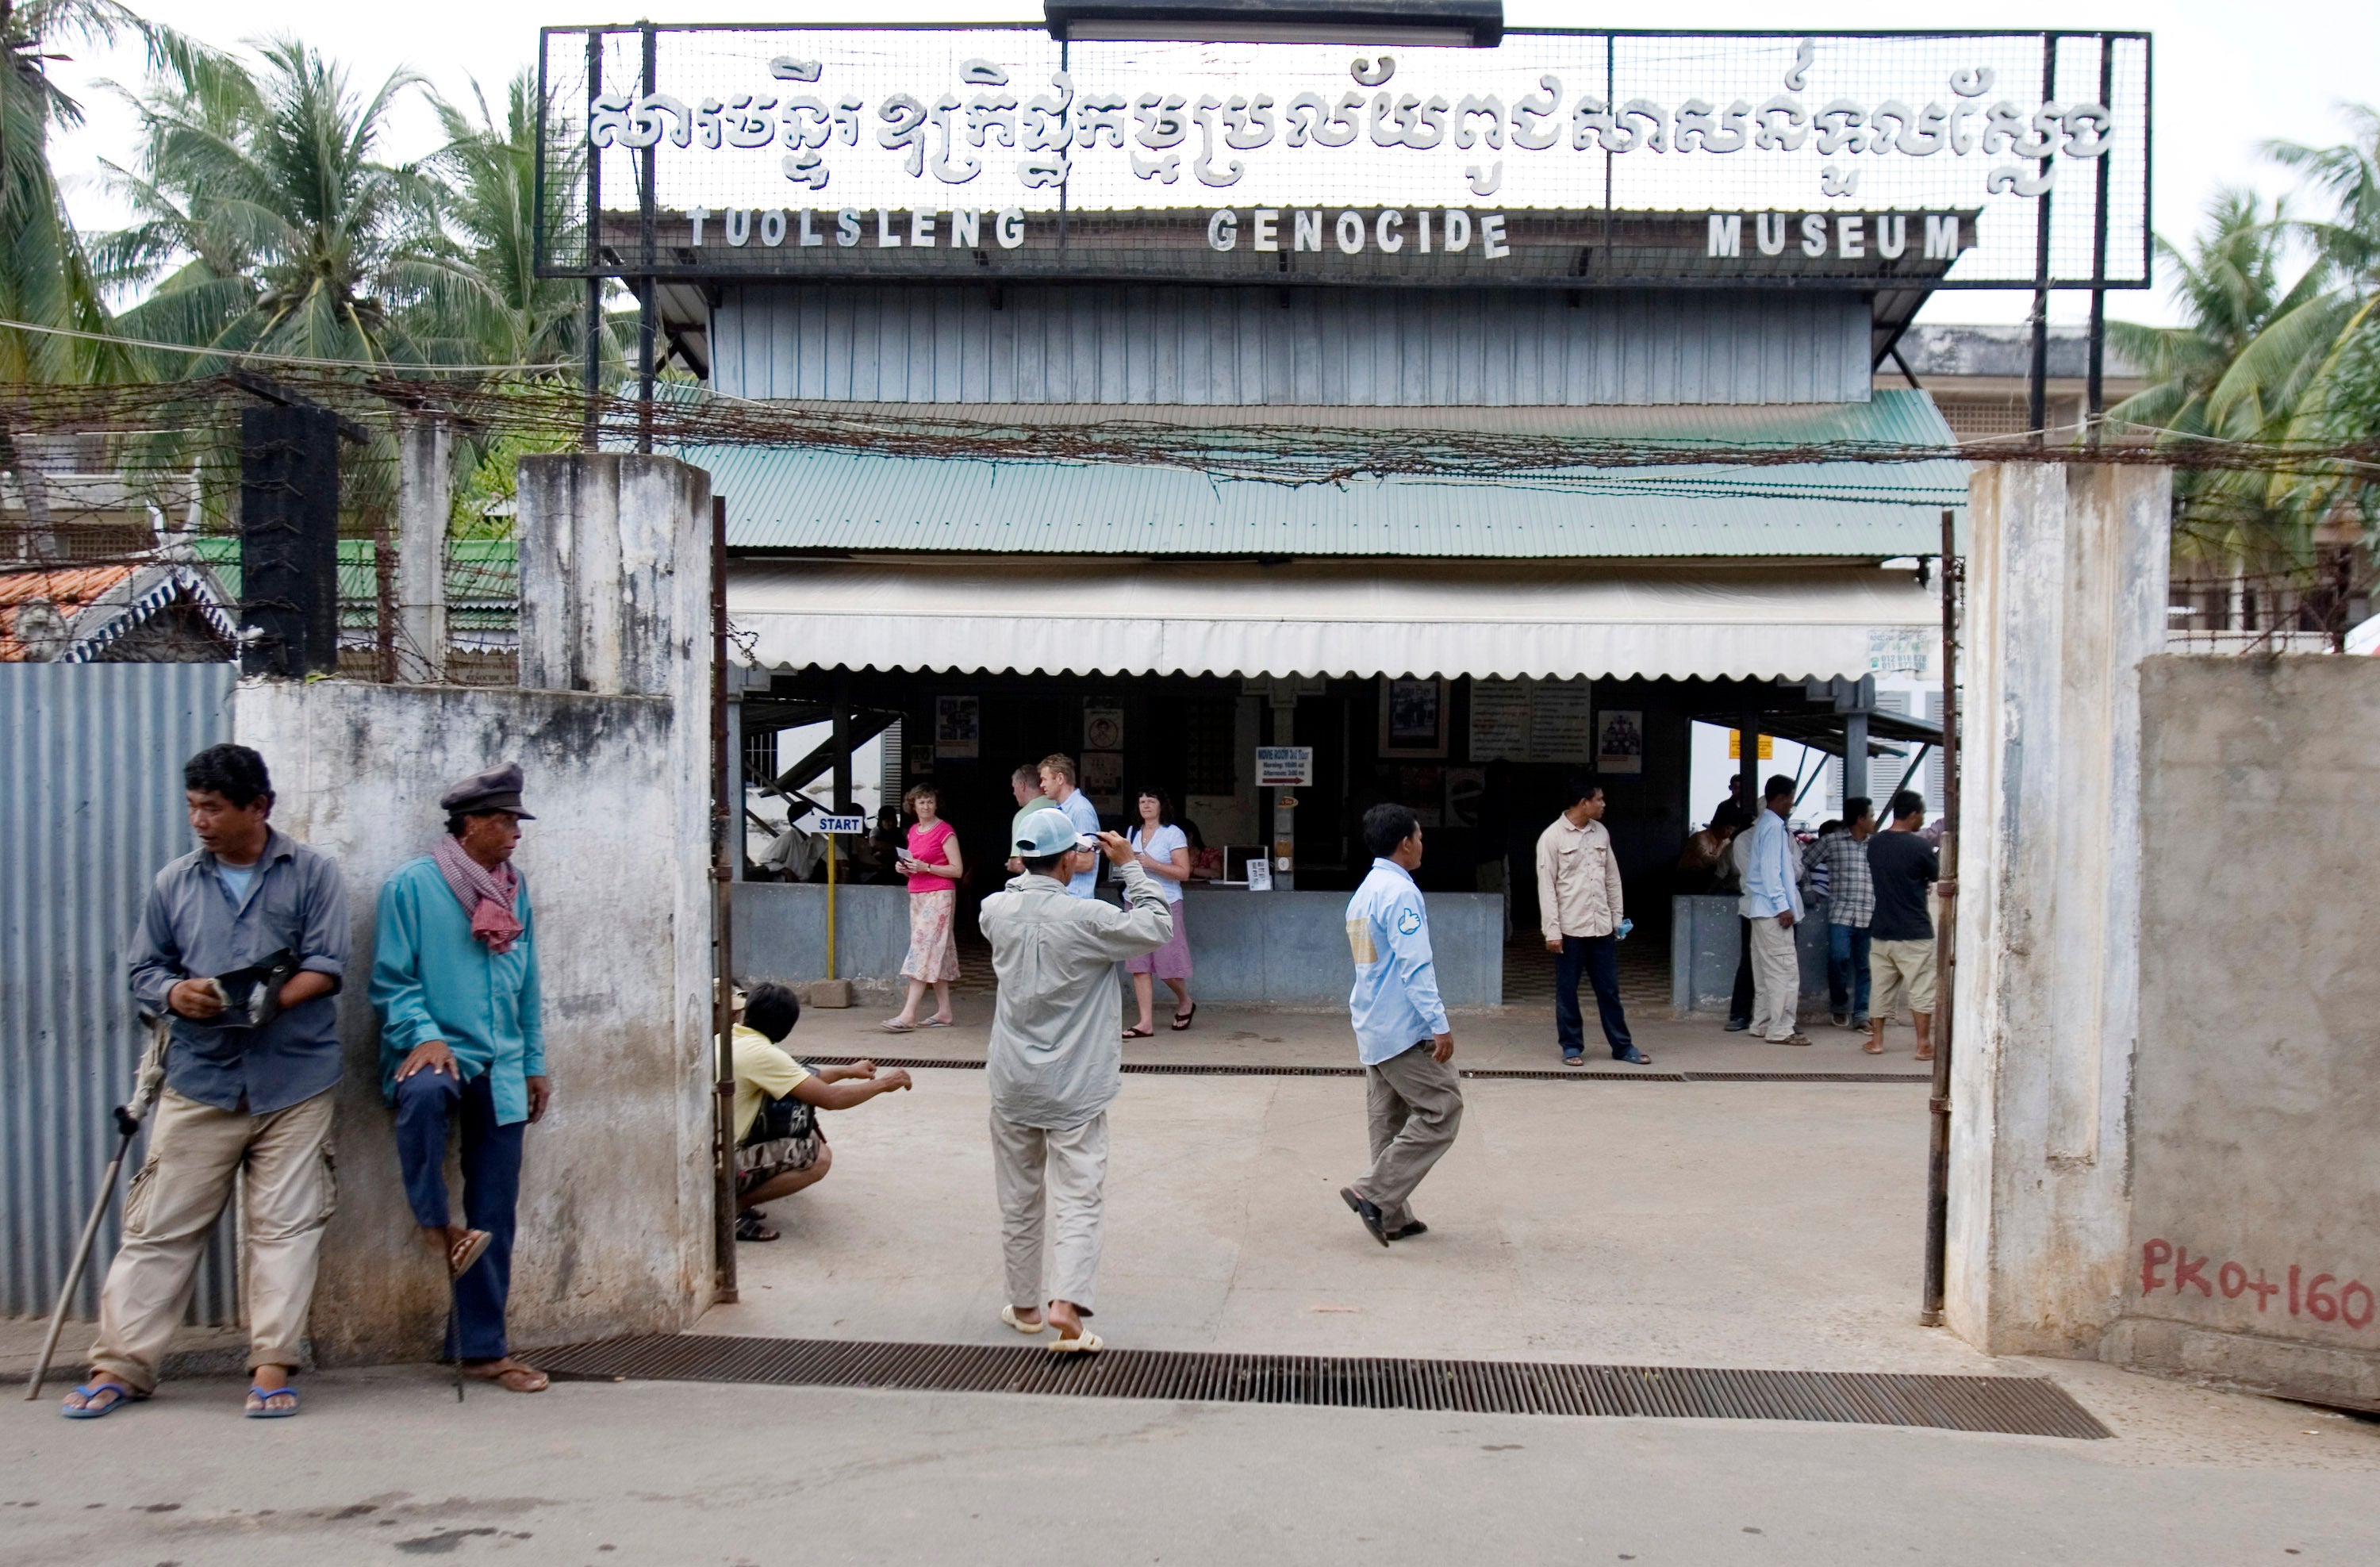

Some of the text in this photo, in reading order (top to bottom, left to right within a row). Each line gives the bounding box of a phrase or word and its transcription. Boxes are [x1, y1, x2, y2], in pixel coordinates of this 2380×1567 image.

[1207, 209, 1510, 259] GENOCIDE
[1707, 213, 1960, 259] MUSEUM
[820, 818, 859, 831] START
